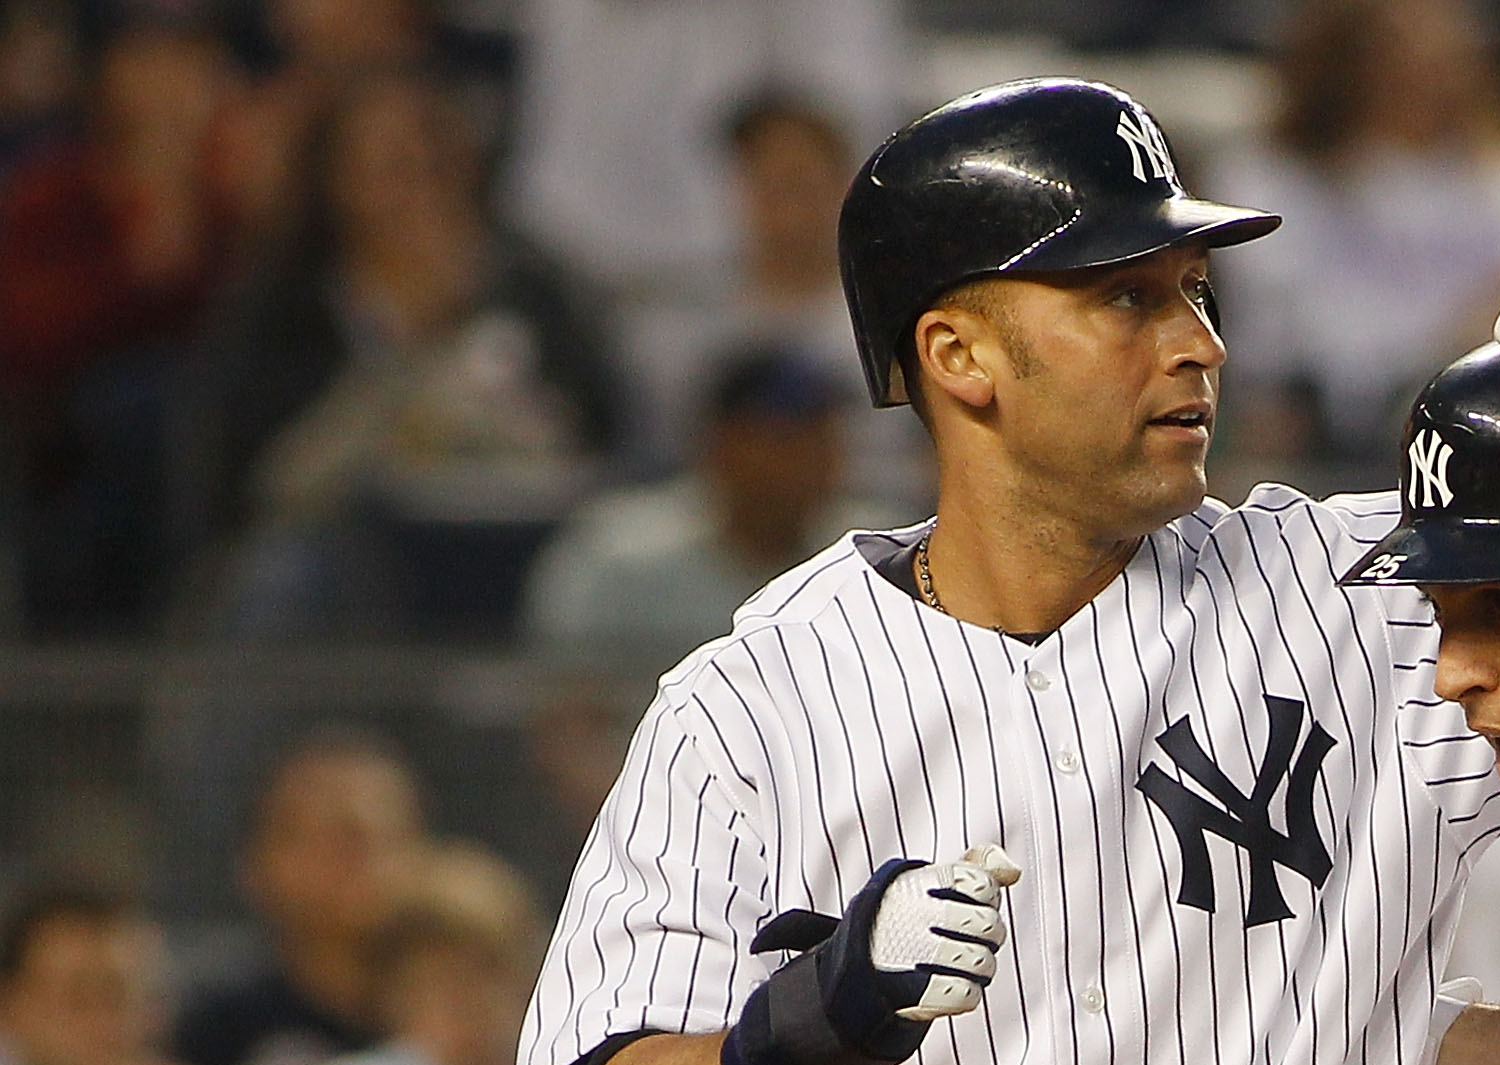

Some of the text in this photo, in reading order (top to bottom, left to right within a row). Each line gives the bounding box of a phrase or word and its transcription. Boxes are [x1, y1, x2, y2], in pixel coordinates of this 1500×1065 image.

[1408, 428, 1454, 510] NY
[1360, 553, 1408, 579] 25
[1134, 693, 1339, 929] NY
